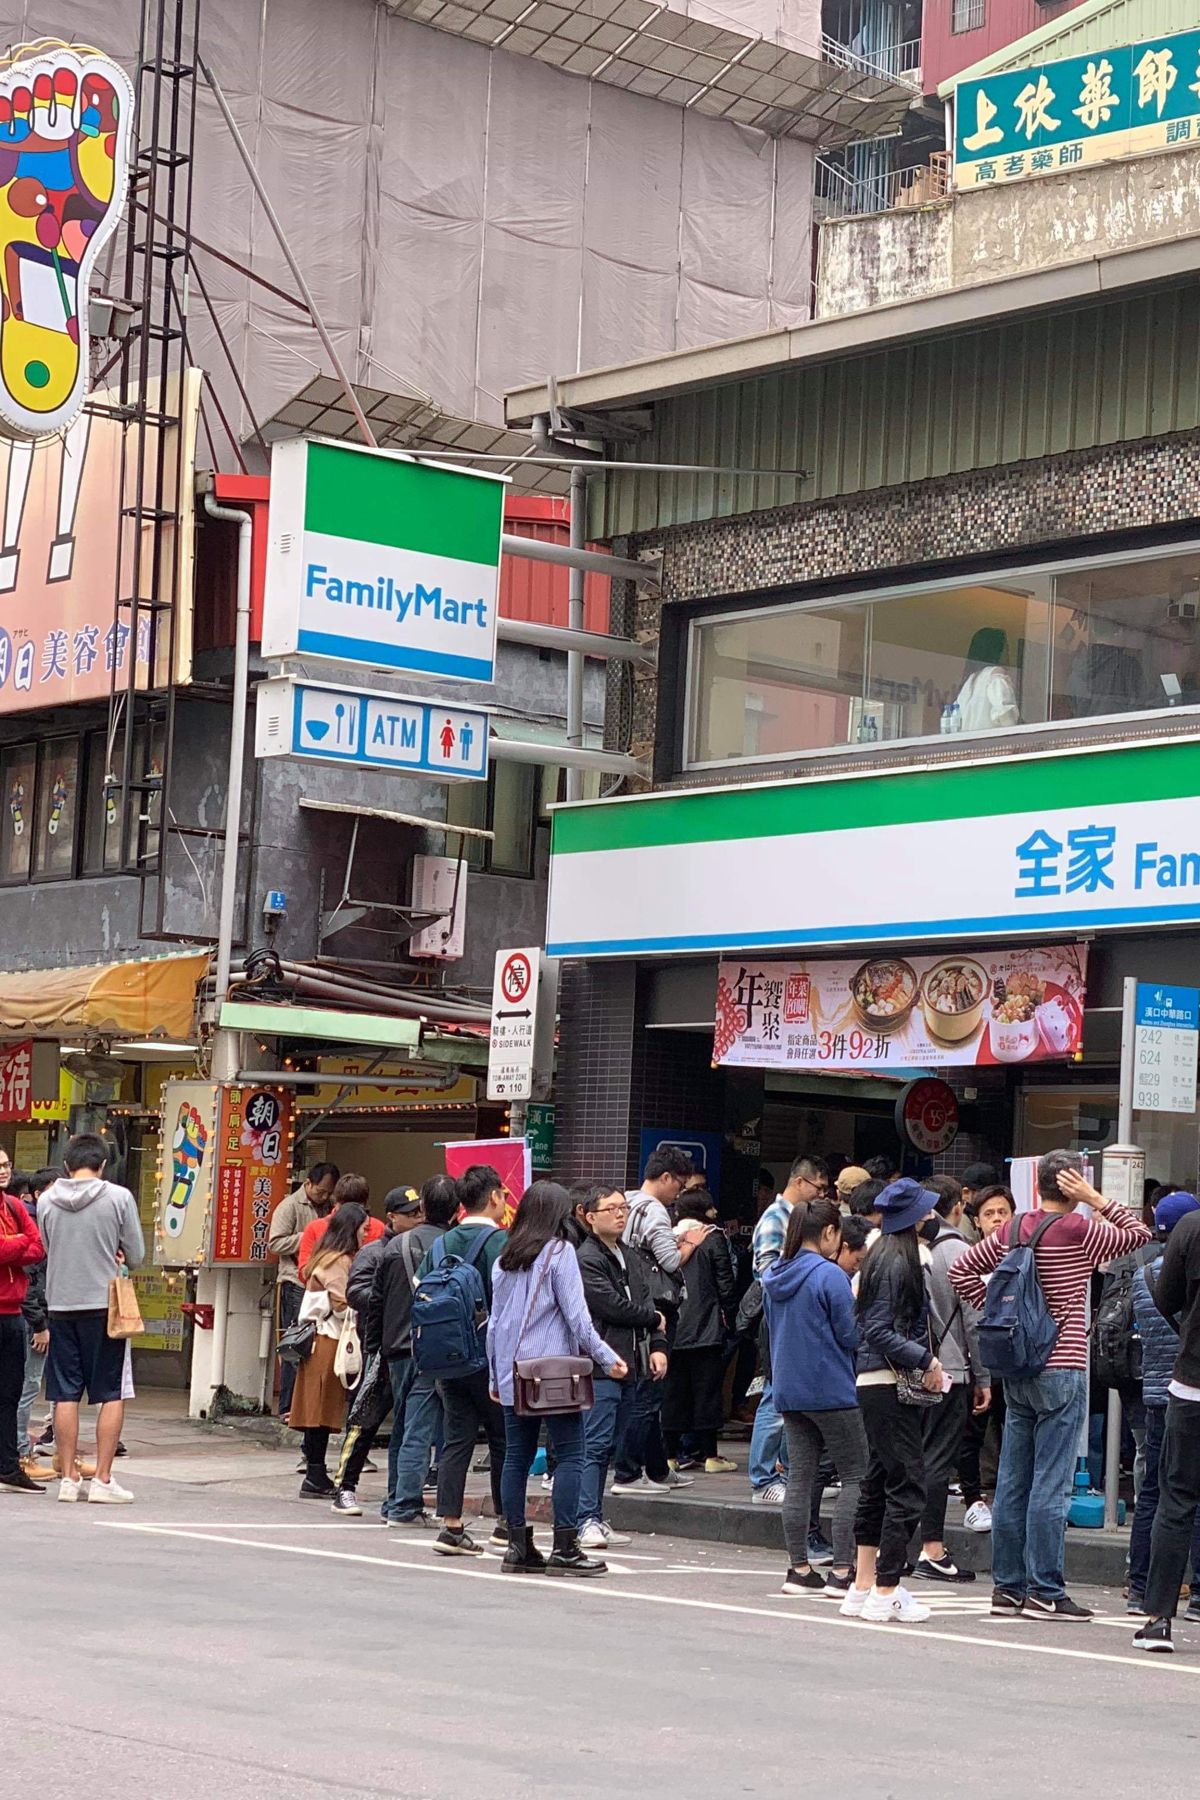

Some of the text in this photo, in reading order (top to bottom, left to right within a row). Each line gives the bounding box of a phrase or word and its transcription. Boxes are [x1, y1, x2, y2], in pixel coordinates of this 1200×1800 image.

[974, 142, 1083, 182] 高考藥師
[306, 563, 488, 628] FamilyMart
[372, 714, 417, 749] ATM
[1015, 825, 1117, 898] 全家
[507, 964, 525, 993] 停
[499, 1040, 531, 1048] SIDEWALK
[1140, 1029, 1162, 1045] 242
[1140, 1050, 1160, 1065] 624
[509, 1084, 522, 1092] 110
[1138, 1091, 1159, 1107] 938
[248, 1095, 281, 1159] 朝日
[250, 1177, 272, 1261] 美容會館
